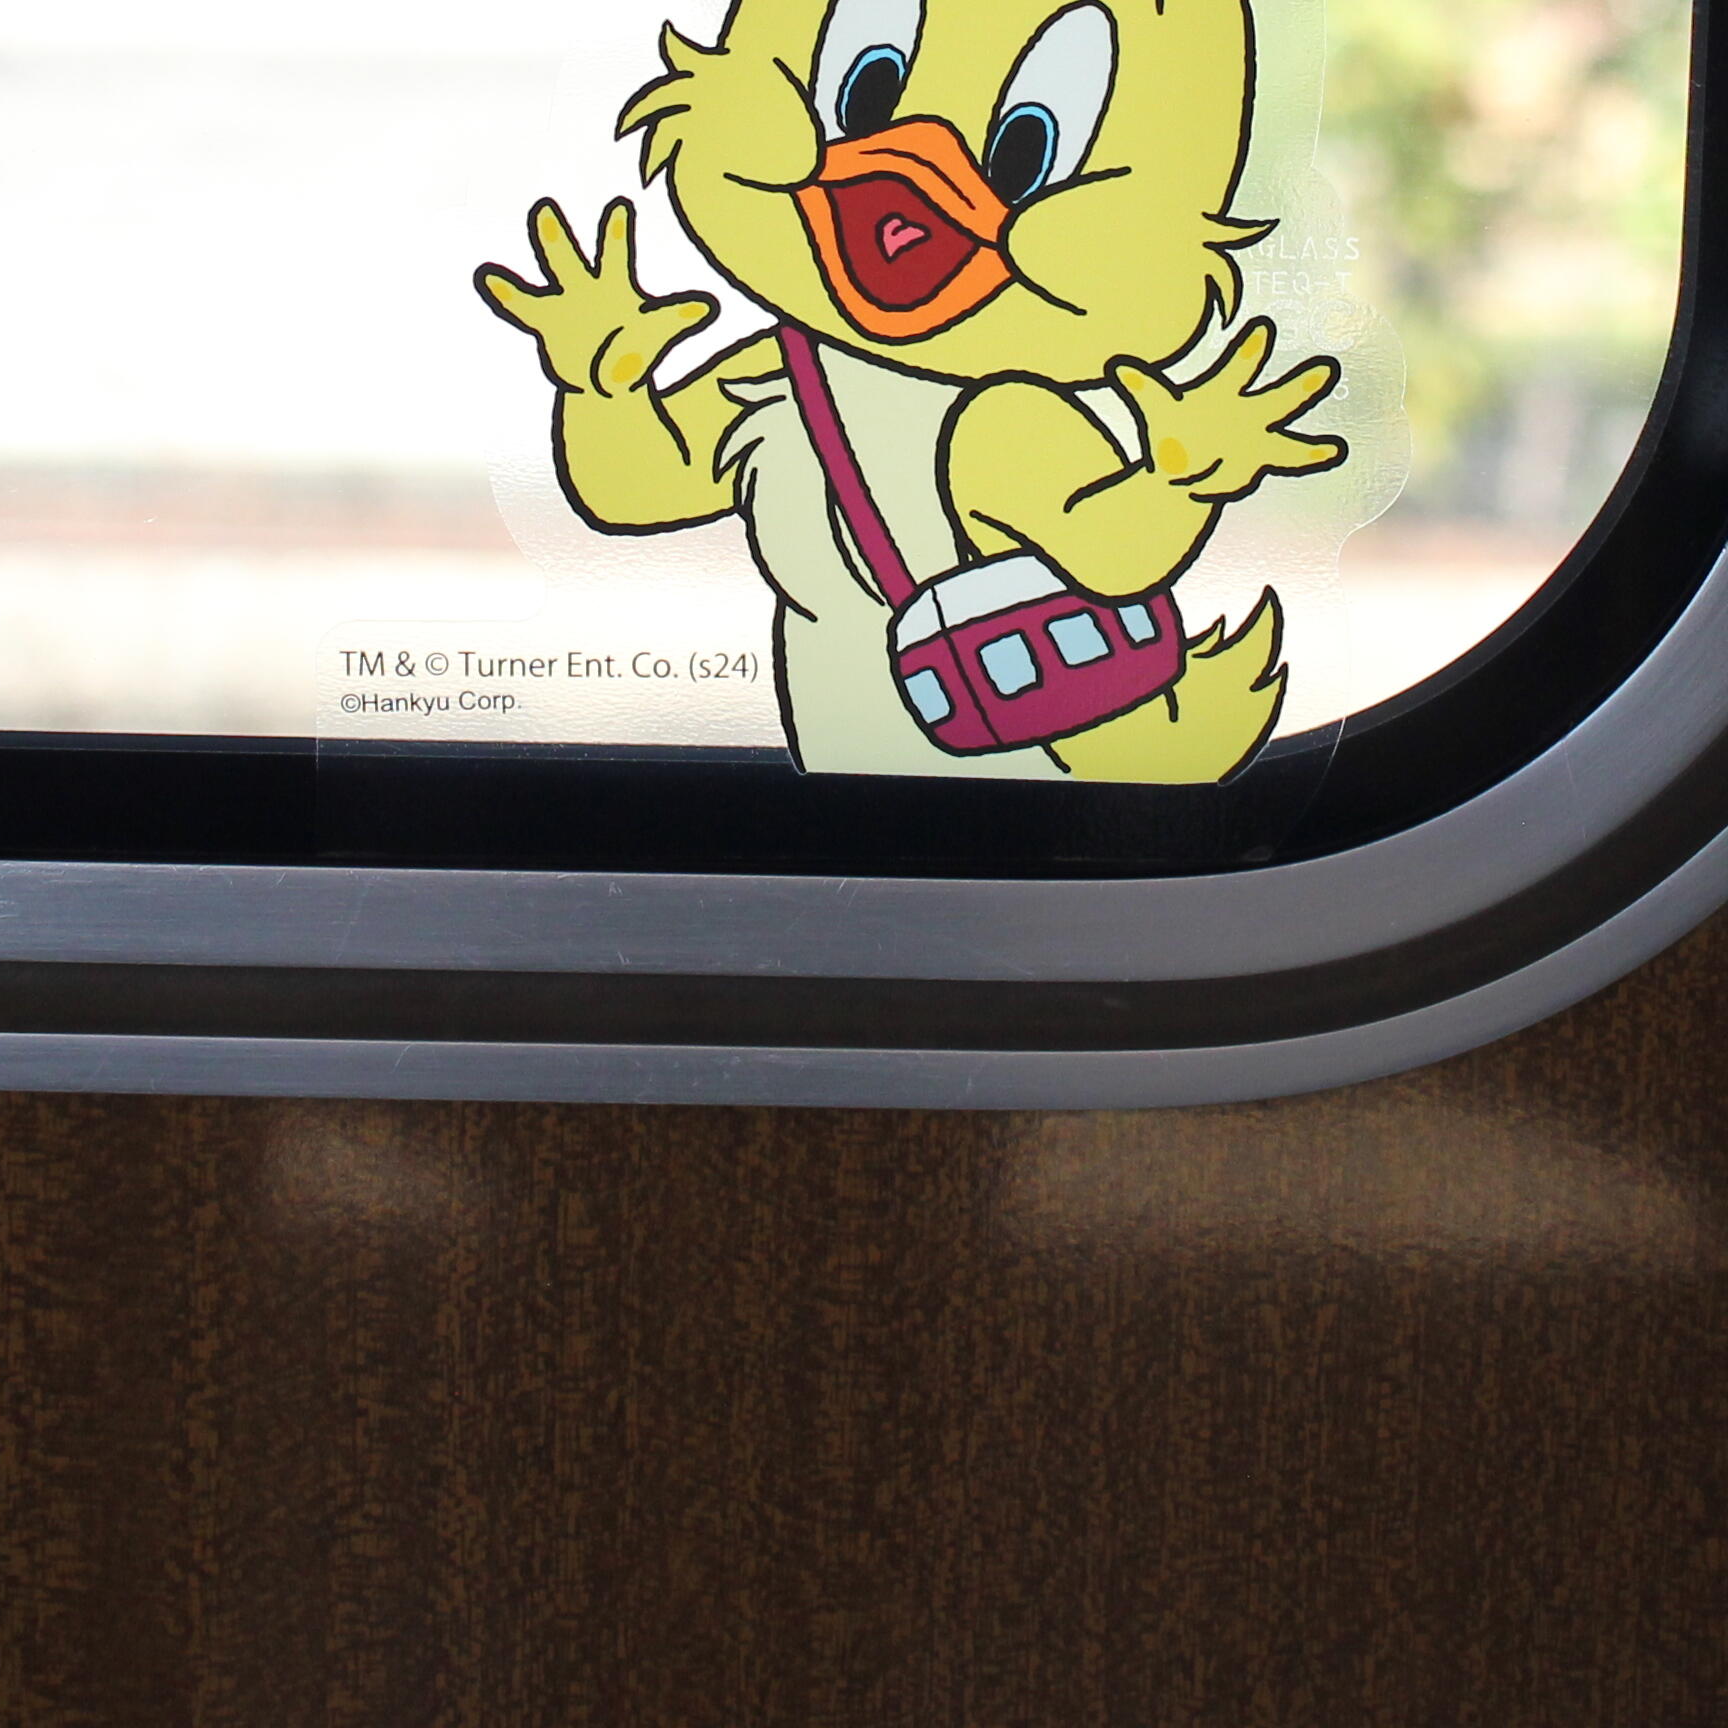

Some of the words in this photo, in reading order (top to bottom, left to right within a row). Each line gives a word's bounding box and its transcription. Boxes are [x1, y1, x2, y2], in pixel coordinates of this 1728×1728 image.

[339, 650, 385, 677] TM
[394, 650, 417, 678] &
[457, 650, 559, 679] Turner
[567, 651, 623, 679] Ent.
[631, 652, 679, 680] Co.
[688, 652, 759, 683] (s24)
[458, 690, 522, 715] Corp.
